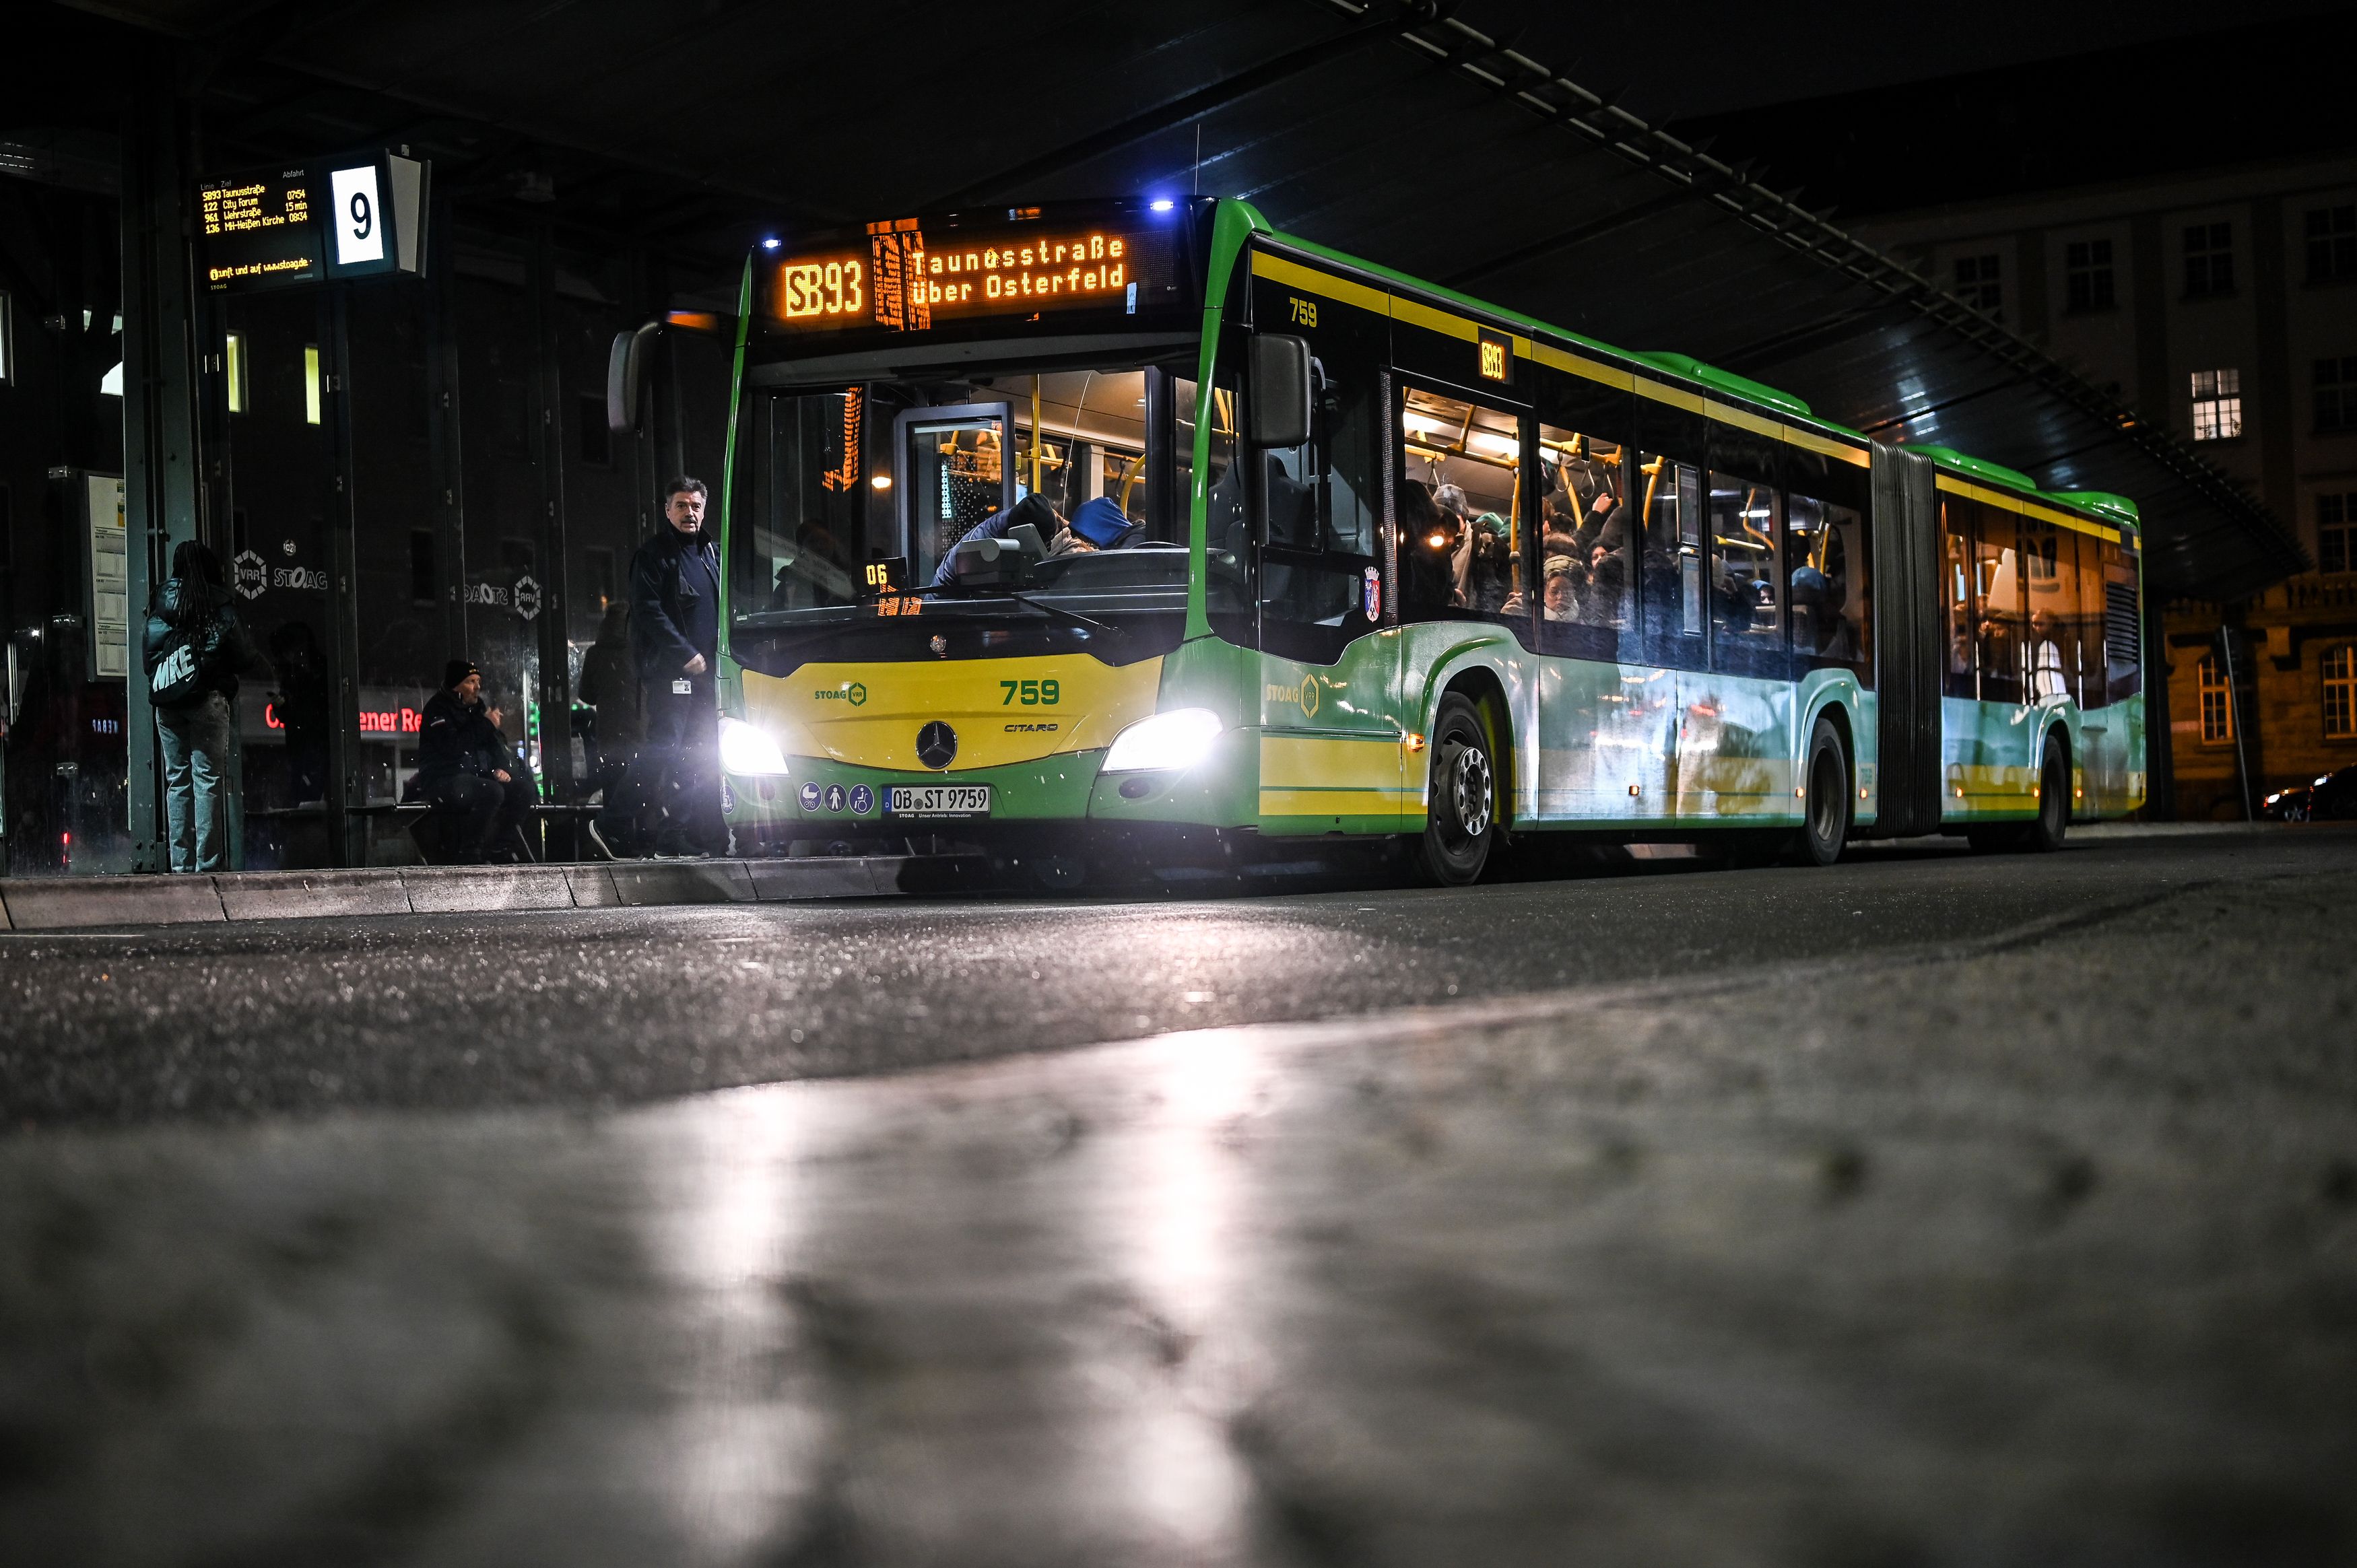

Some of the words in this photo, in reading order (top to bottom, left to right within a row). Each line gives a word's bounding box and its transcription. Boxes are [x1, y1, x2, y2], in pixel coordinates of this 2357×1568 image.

[221, 180, 232, 188] Ziel
[283, 170, 304, 178] Abfahrt
[203, 190, 222, 201] SB93
[222, 184, 265, 198] Taunusstraße
[203, 201, 218, 212] 122
[223, 199, 237, 210] City
[238, 198, 258, 207] Forum
[287, 189, 306, 201] 07:54
[205, 212, 219, 223] 961
[224, 207, 261, 220] Wehrstraße
[286, 202, 294, 212] 15
[294, 201, 308, 211] min
[205, 224, 220, 234] 136
[224, 219, 261, 231] MH-Heißen
[262, 215, 285, 226] Kirche
[289, 211, 308, 222] 08:34
[350, 192, 372, 240] 9
[912, 235, 1123, 275] Taunusstraße
[236, 265, 248, 275] und
[250, 263, 261, 275] auf
[785, 261, 862, 317] SB93
[913, 280, 972, 304] über
[987, 263, 1123, 298] Osterfeld
[1290, 297, 1317, 328] 759
[1482, 341, 1502, 380] SB93
[239, 568, 260, 580] VRR
[274, 566, 328, 590] STOAG
[866, 564, 888, 585] 06
[815, 690, 846, 700] STOAG
[1000, 680, 1059, 705] 759
[1266, 683, 1299, 703] STOAG
[1304, 691, 1315, 701] VRR
[360, 711, 398, 732] ener
[401, 708, 422, 732] Re
[1004, 724, 1058, 732] CITARO
[893, 789, 912, 809] OB
[925, 789, 943, 809] ST
[948, 788, 987, 809] 9759
